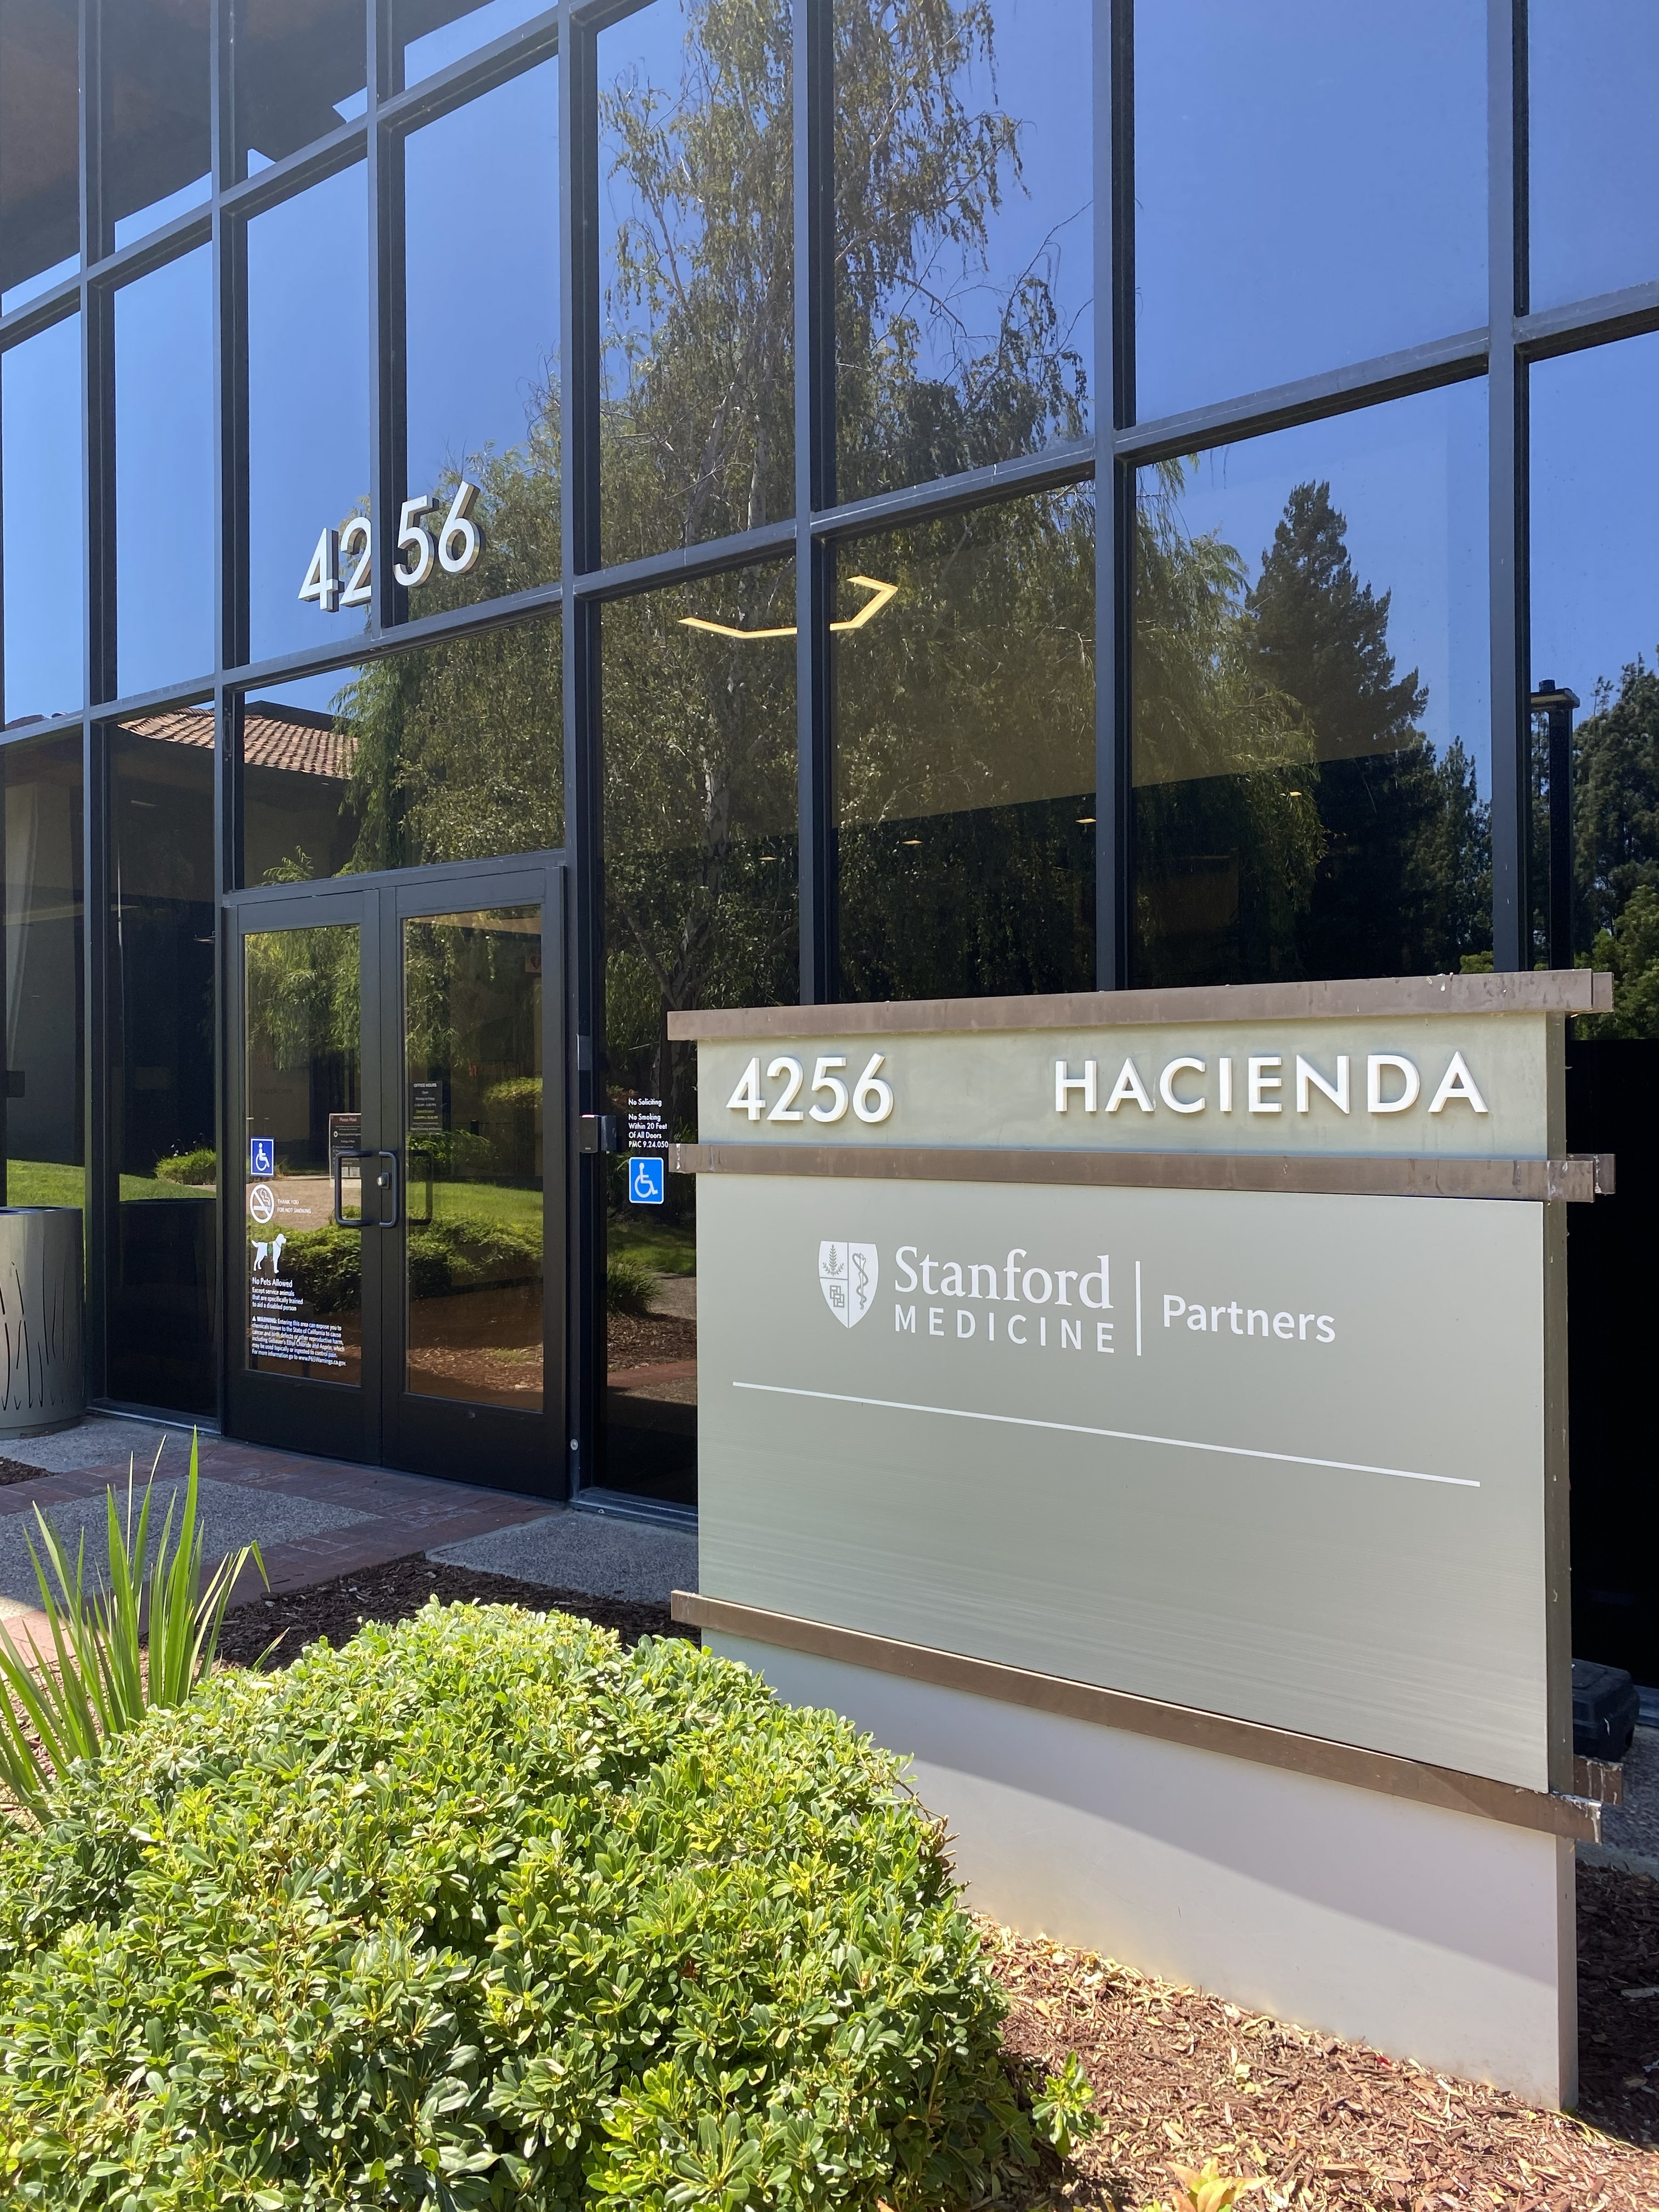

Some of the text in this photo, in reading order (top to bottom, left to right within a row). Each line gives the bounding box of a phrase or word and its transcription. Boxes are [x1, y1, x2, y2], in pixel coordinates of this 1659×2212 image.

[298, 481, 481, 612] 4256
[726, 1051, 1489, 1123] 4256 HACIENDA
[638, 1098, 662, 1107] Soliciting
[638, 1113, 661, 1122] Smoking
[252, 1277, 293, 1288] No Pets Allowed
[895, 1246, 1114, 1310] Stanford
[252, 1286, 265, 1295] Except
[267, 1295, 289, 1305] specifically
[257, 1316, 277, 1324] WARNING:
[277, 1318, 292, 1327] Entering
[1164, 1295, 1336, 1344] Partners
[895, 1304, 1115, 1354] MEDICINE
[268, 1350, 289, 1359] information
[274, 1345, 289, 1353] topically
